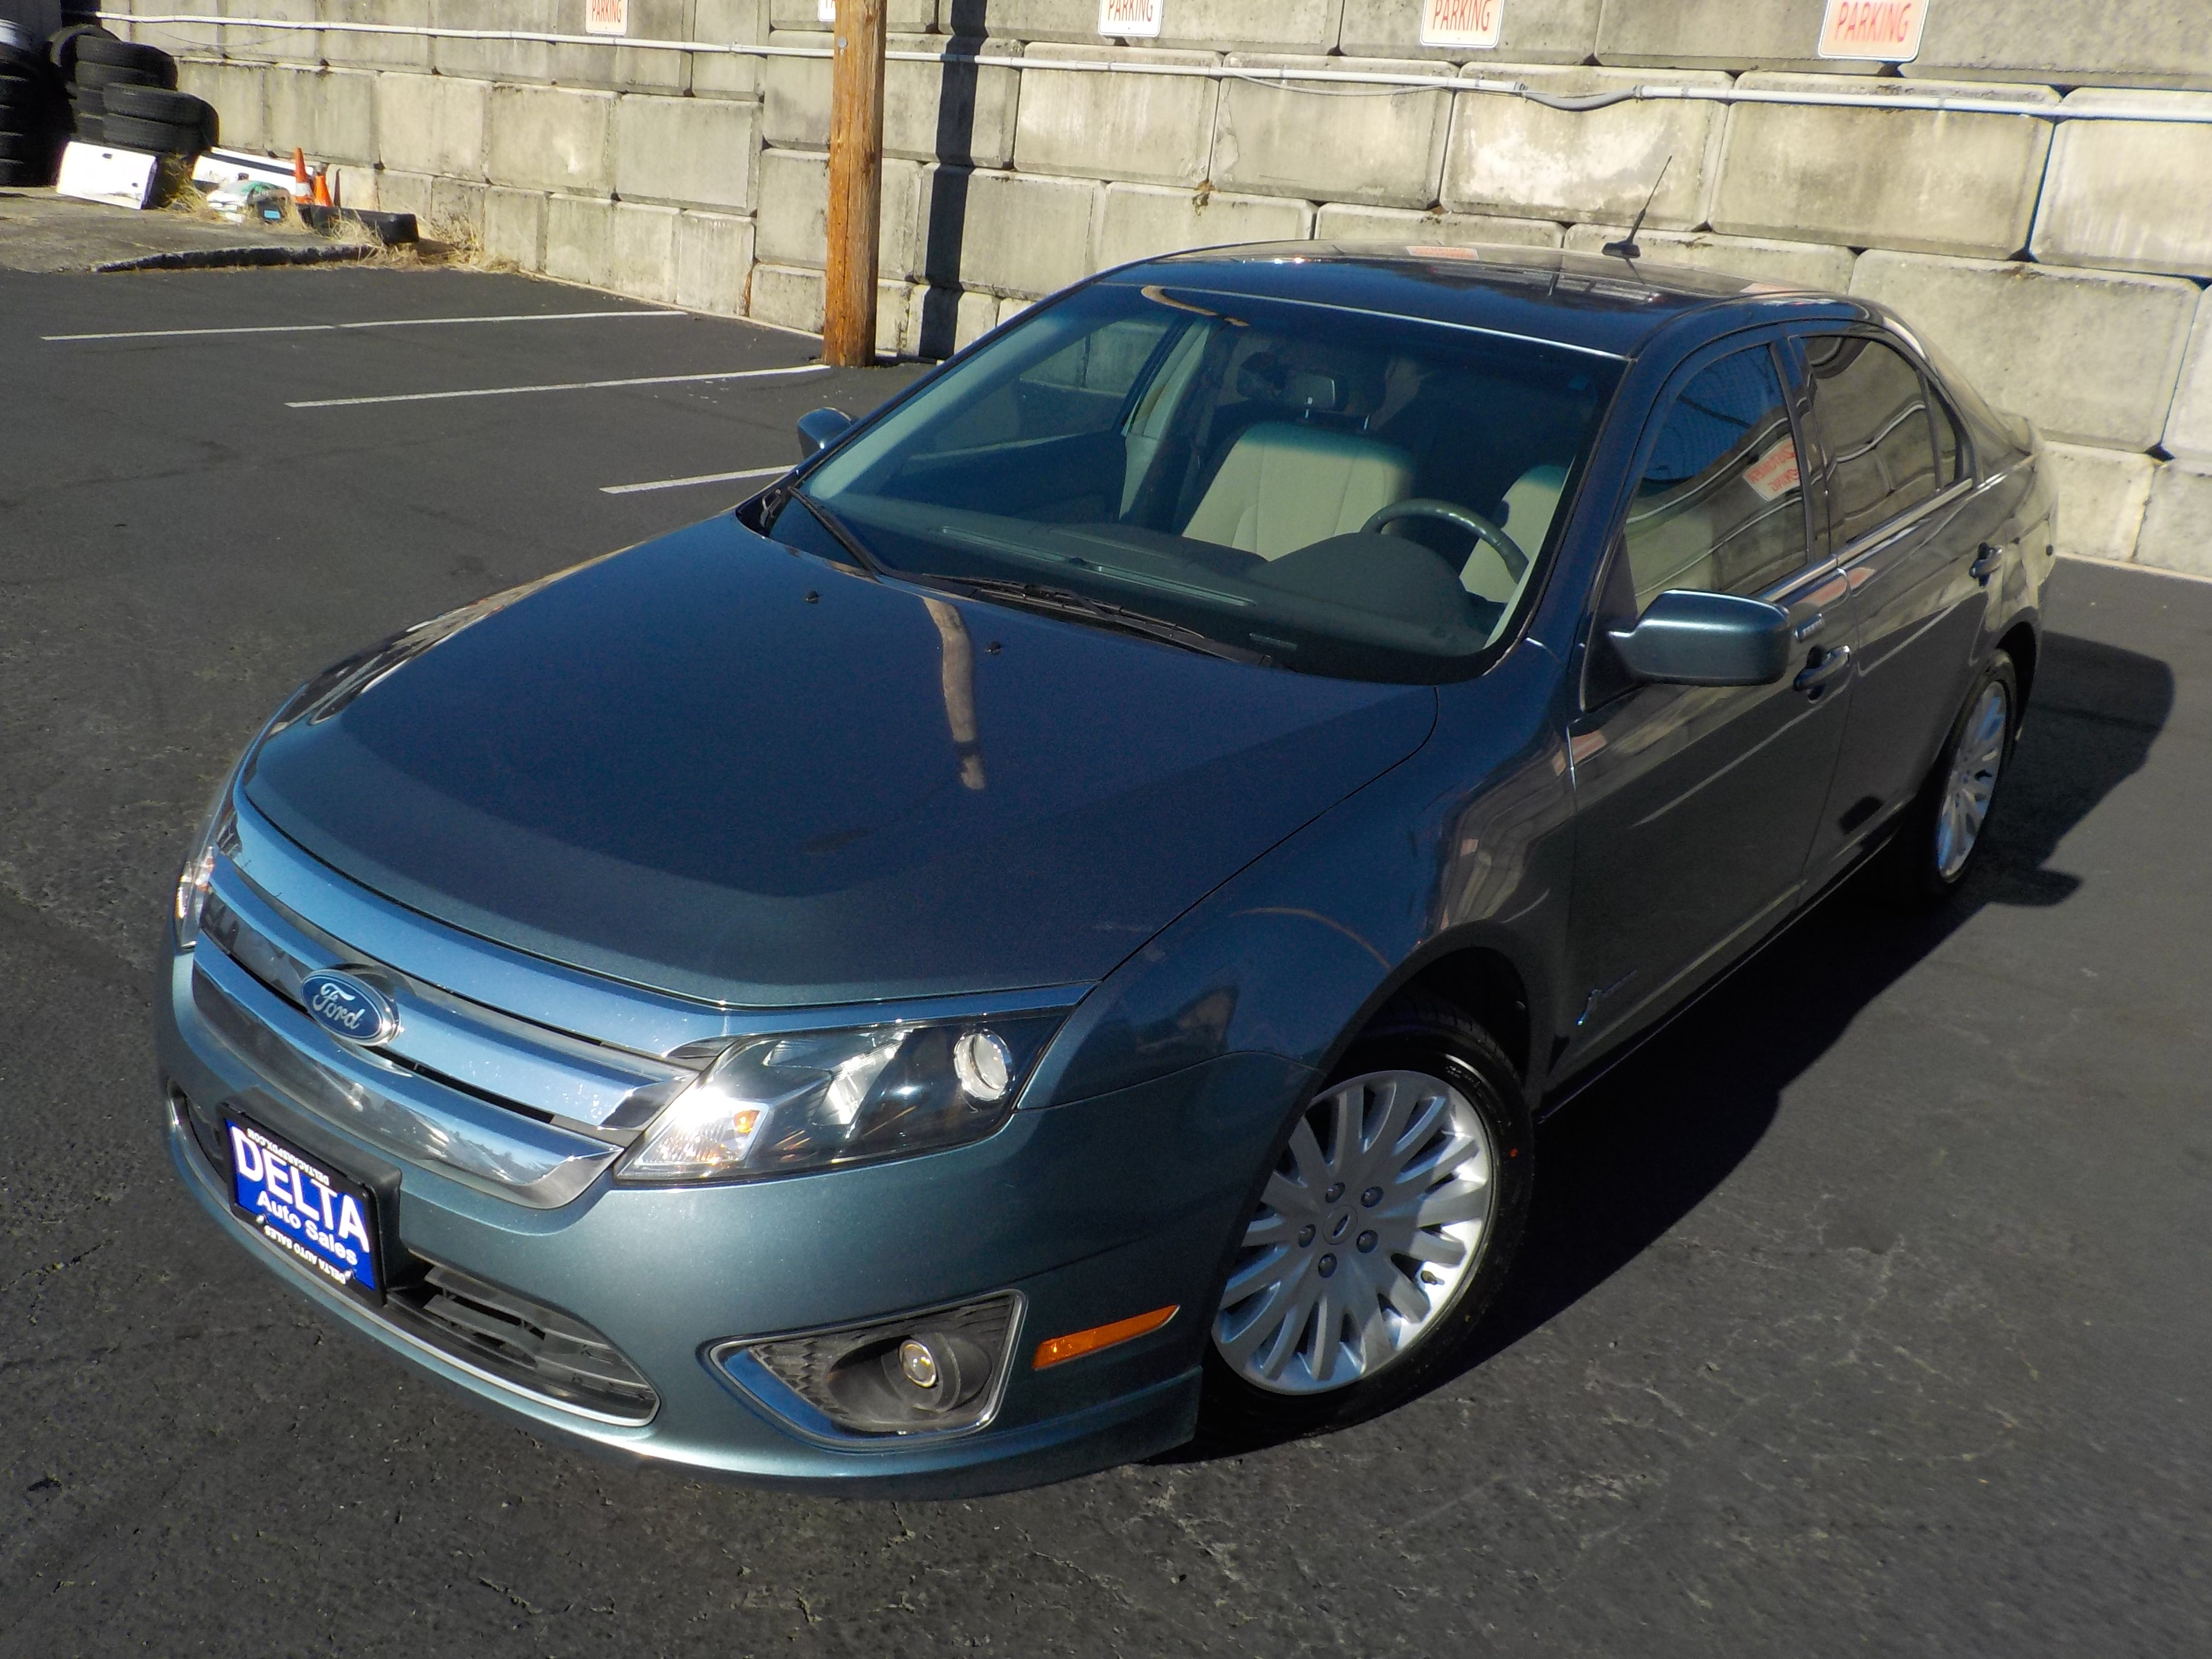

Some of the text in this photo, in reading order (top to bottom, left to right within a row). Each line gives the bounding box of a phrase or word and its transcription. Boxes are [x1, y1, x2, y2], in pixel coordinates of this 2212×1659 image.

[592, 0, 621, 22] PARKING
[1108, 0, 1153, 22] PARKING
[1432, 0, 1490, 31] PARKING
[1835, 2, 1912, 42] PARKING
[312, 983, 366, 1029] Ford
[231, 1125, 370, 1253] DELTA
[256, 1190, 358, 1266] Auto Sales
[263, 1225, 346, 1285] DELTA AUTO SALES
